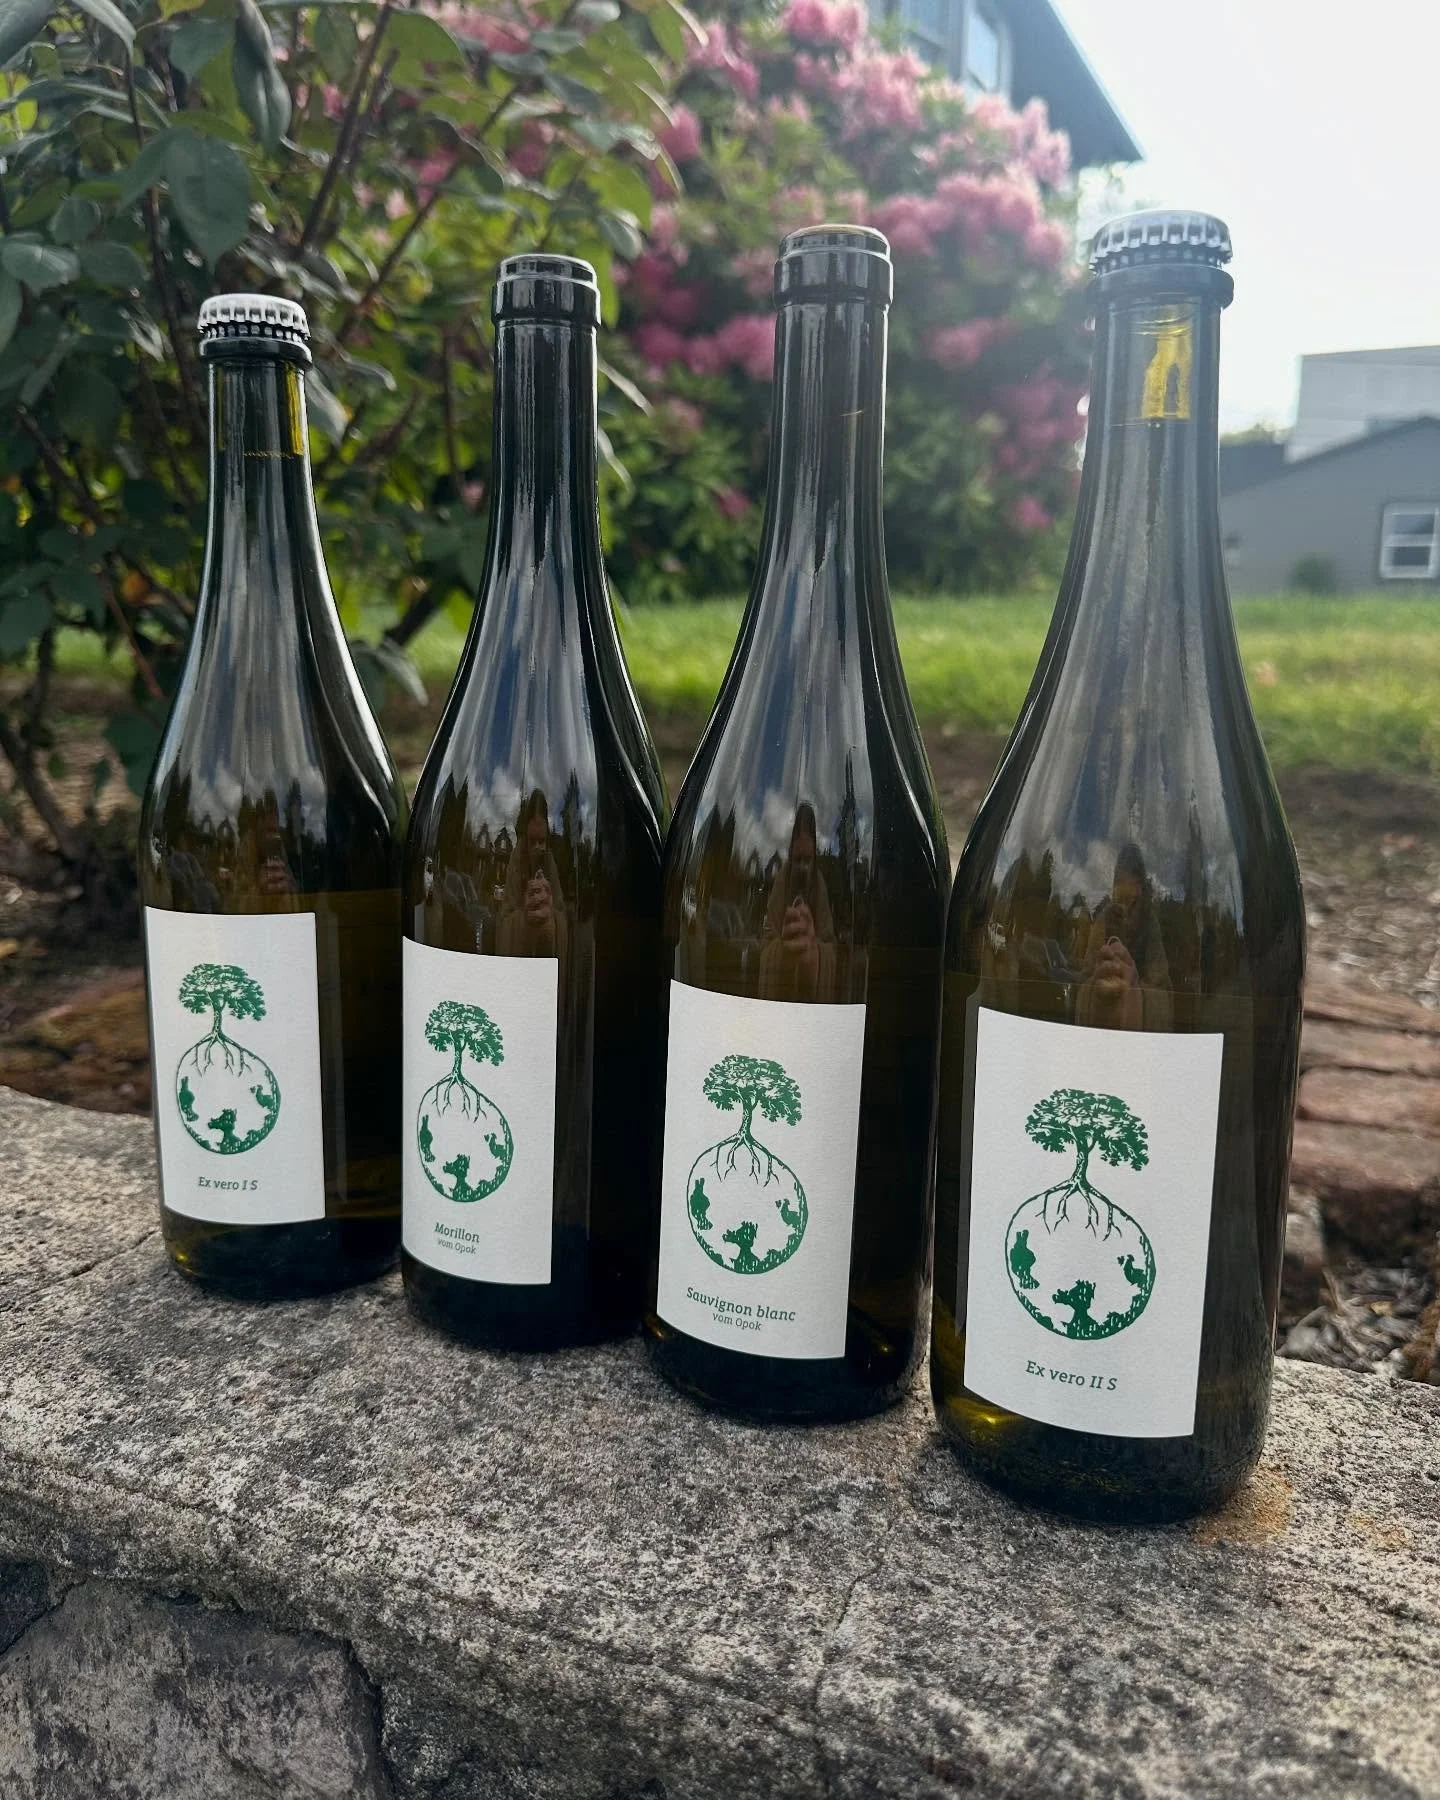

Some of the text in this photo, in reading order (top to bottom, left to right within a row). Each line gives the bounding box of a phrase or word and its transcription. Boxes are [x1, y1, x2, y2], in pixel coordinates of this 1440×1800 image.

[197, 1176, 259, 1191] Ex vero I S
[434, 1221, 480, 1243] Morillon
[437, 1238, 477, 1255] vom Opok
[686, 1286, 797, 1323] Sauvignon blanc
[712, 1312, 763, 1332] vom Opok
[1024, 1359, 1118, 1391] Ex vero II S
